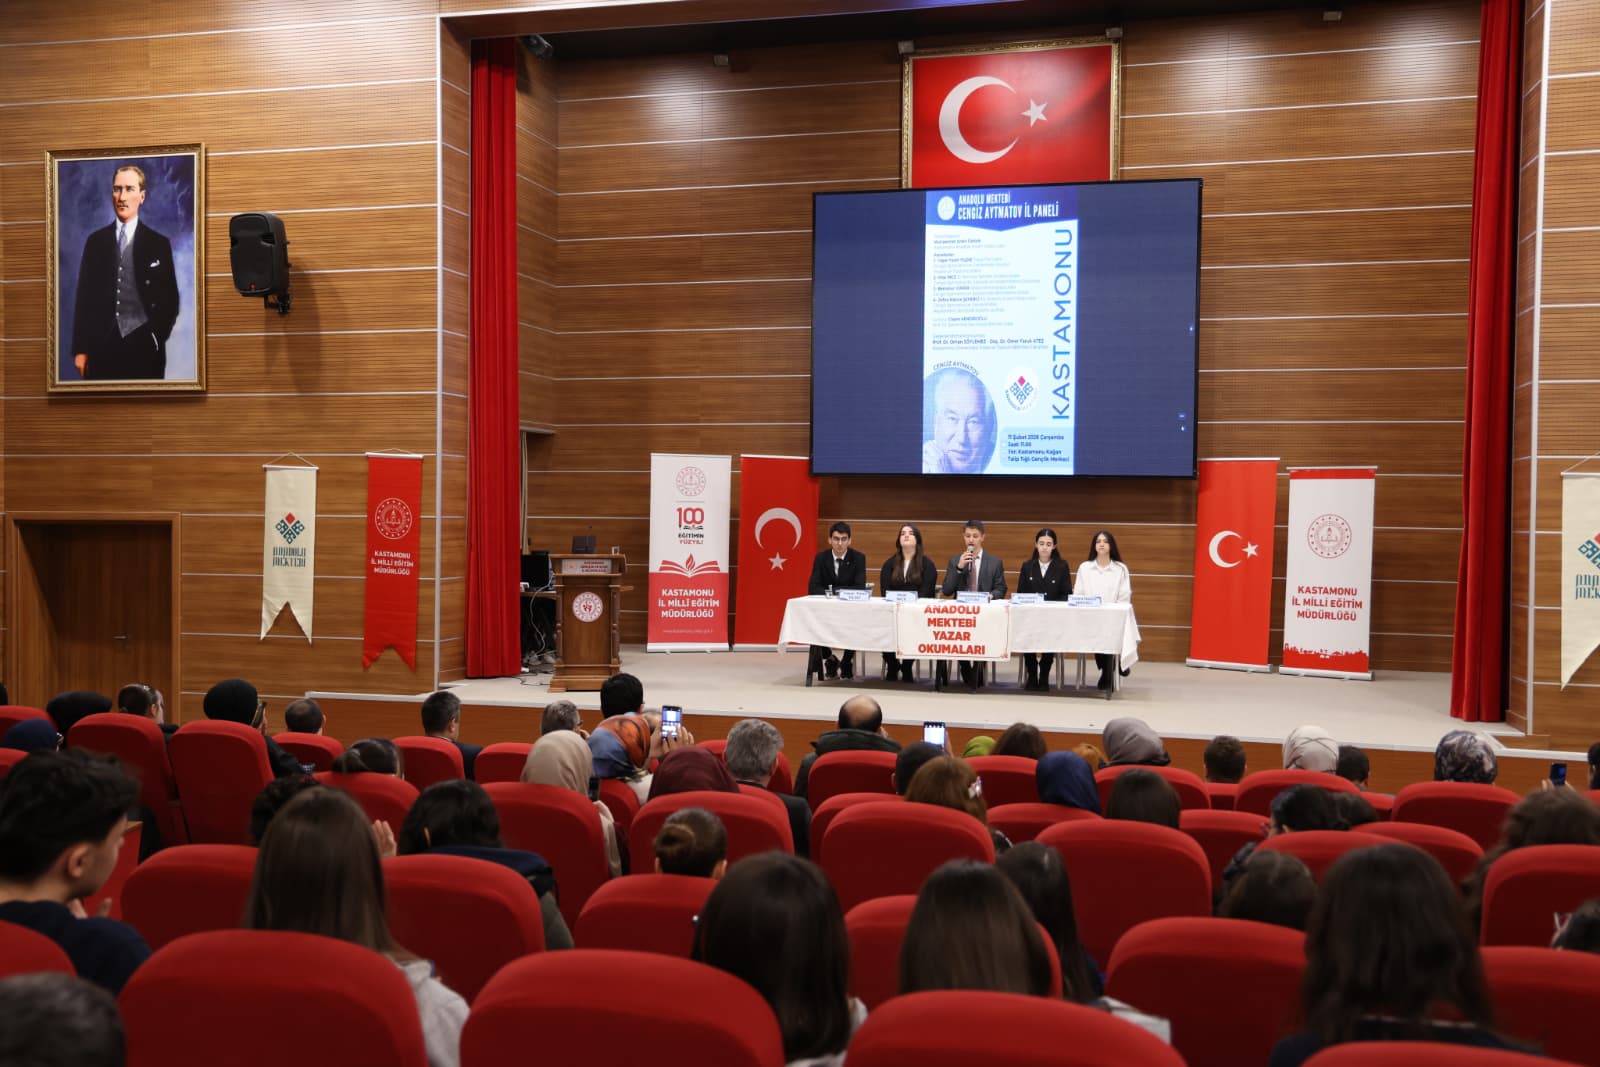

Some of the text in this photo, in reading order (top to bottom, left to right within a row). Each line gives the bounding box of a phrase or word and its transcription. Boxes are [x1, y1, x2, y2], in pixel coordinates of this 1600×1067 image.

[959, 191, 1011, 205] ANADOLU MEKTEBİ
[958, 201, 1059, 220] CENGİZ AYTMATOV İL PANELİ
[1052, 229, 1073, 420] KASTAMONU
[677, 507, 704, 527] 100
[374, 550, 410, 559] KASTAMONU
[378, 558, 393, 566] MİLLİ
[394, 559, 414, 567] EĞİTİM
[374, 566, 410, 575] MÜDÜRLÜĞÜ
[662, 589, 714, 597] KASTAMONU
[1298, 586, 1357, 596] KASTAMONU
[658, 598, 719, 607] İL MİLLİ EĞİTİM
[1292, 595, 1362, 609] İL MİLLİ EĞİTİM
[661, 609, 714, 618] MÜDÜRLÜĞÜ
[924, 605, 980, 614] ANADOLU
[1297, 609, 1357, 621] MÜDÜRLÜĞÜ
[928, 616, 976, 627] MEKTEBİ
[933, 630, 971, 641] YAZAR
[918, 643, 985, 654] OKUMALARI
